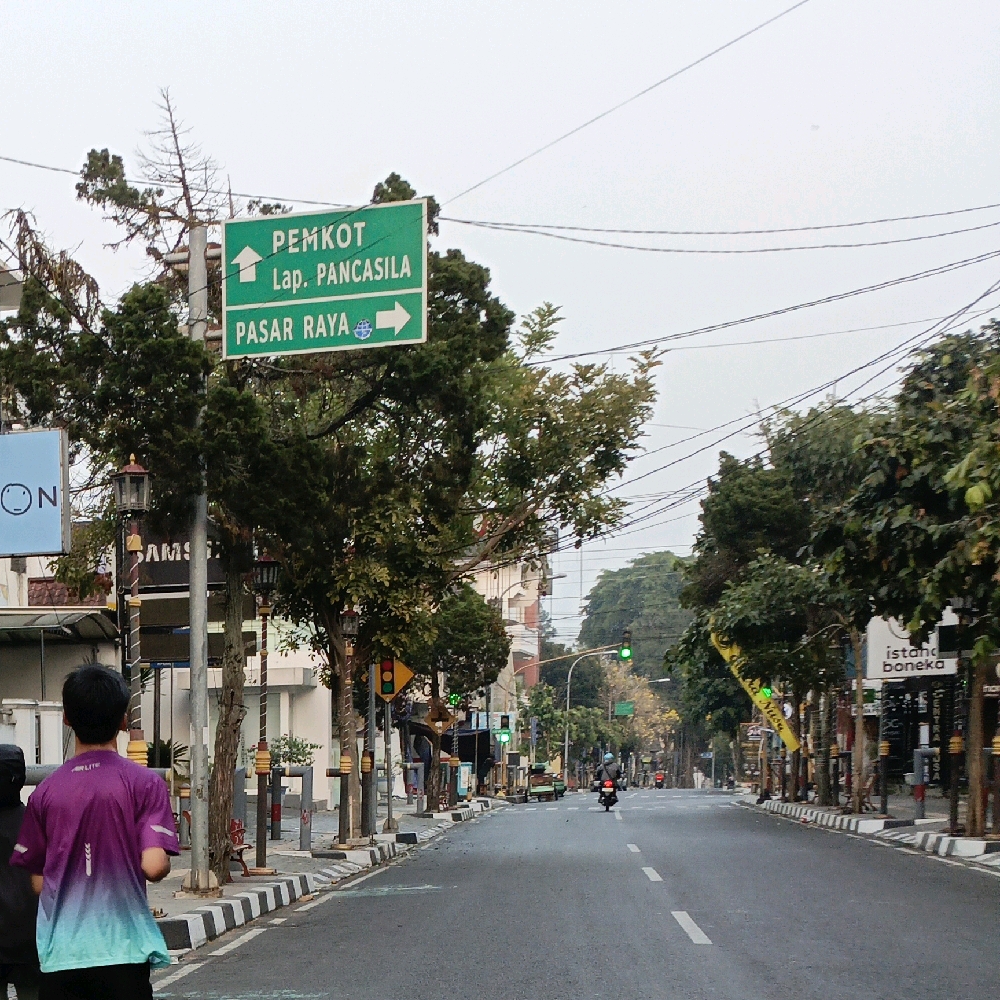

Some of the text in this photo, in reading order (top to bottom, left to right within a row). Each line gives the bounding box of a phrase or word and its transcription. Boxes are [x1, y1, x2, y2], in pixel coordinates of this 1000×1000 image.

[272, 221, 366, 255] PEMKOT
[273, 254, 411, 294] Lap. PANCASILA
[236, 312, 349, 345] PASAR RAYA
[882, 659, 945, 673] boneka
